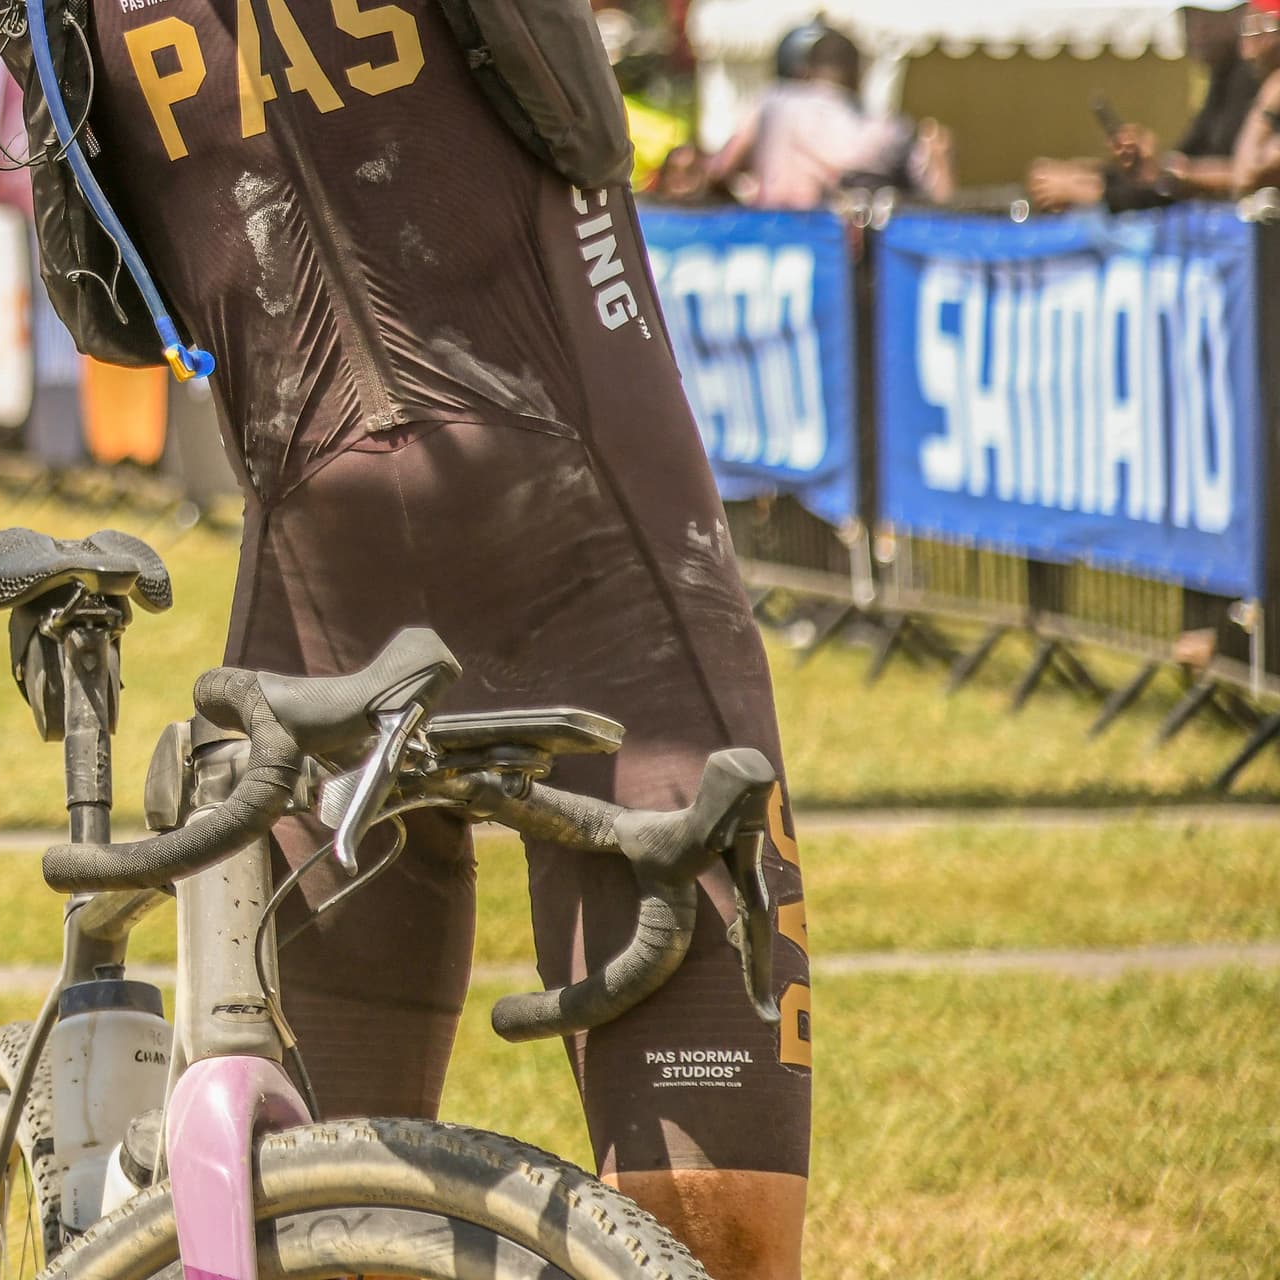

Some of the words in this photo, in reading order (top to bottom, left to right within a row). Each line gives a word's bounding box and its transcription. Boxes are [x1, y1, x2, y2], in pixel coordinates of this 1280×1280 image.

[914, 253, 1235, 537] SHIMANO
[211, 1003, 269, 1016] FELT
[645, 1051, 676, 1064] PAS
[679, 1050, 754, 1064] NORMAL
[661, 1066, 735, 1079] STUDIOS
